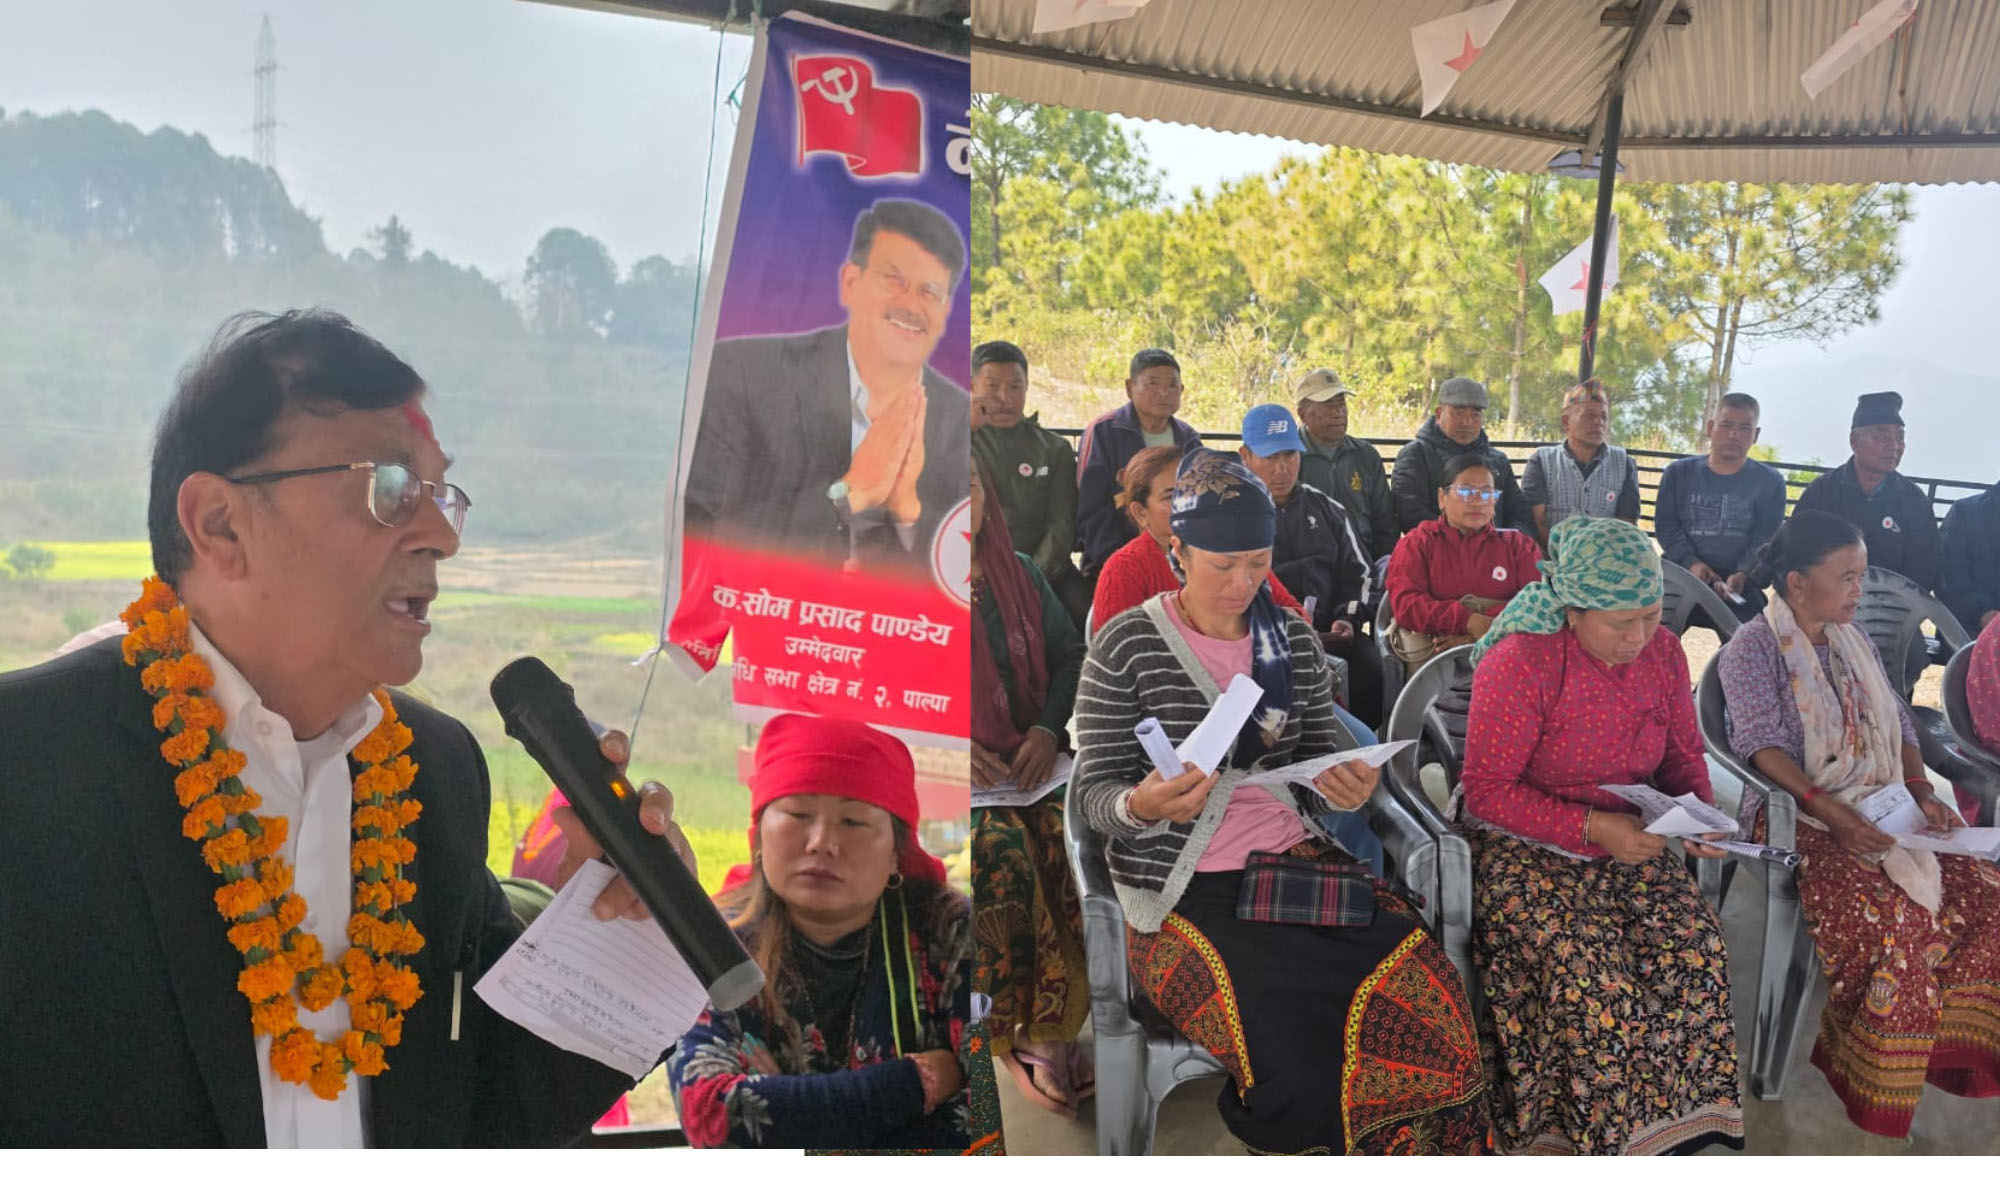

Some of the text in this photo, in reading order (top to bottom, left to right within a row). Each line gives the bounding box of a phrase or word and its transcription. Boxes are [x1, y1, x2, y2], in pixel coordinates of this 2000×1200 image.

[799, 601, 867, 634] प्रसाद
[871, 613, 954, 647] पाण्डेय
[784, 635, 867, 670] उम्मेदवार
[764, 667, 802, 690] सभा
[807, 670, 841, 696] क्षेत्र
[902, 689, 952, 713] पाल्पा
